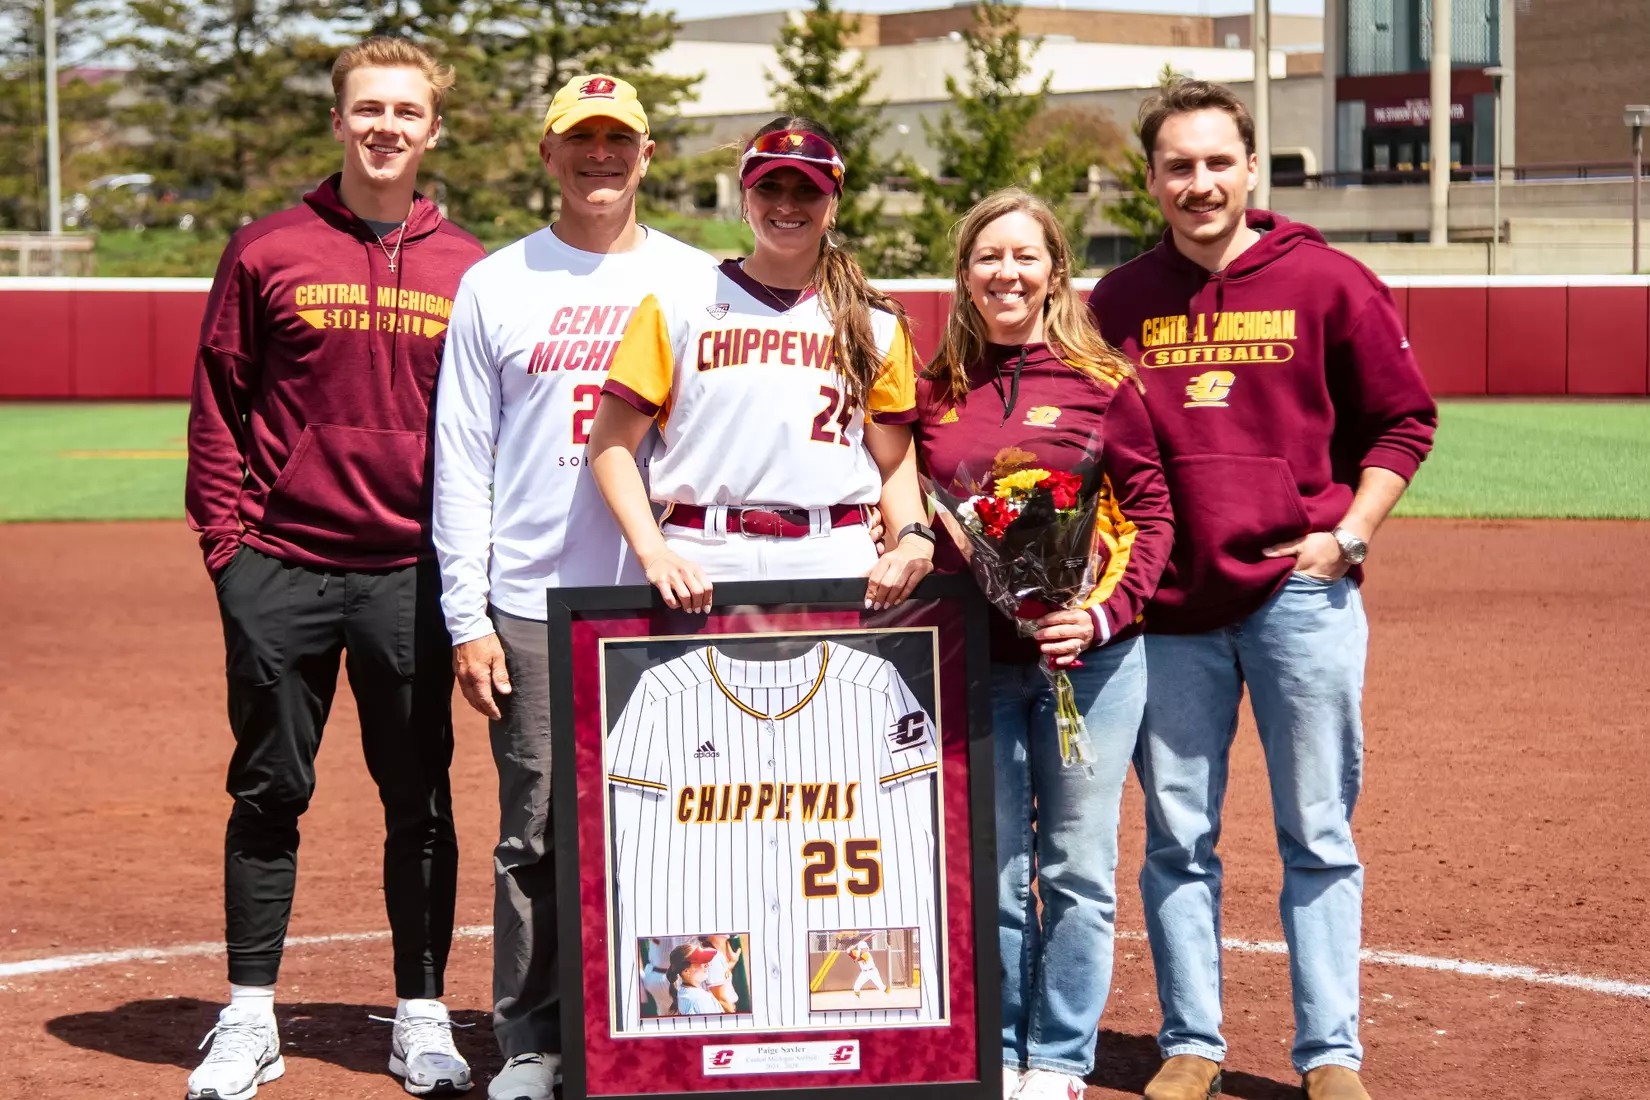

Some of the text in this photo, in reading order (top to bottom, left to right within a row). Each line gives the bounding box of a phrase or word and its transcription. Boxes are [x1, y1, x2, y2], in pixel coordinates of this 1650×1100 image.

[295, 283, 369, 306] CENTRAL
[1154, 345, 1279, 365] SOFTBALL
[693, 751, 720, 759] adidas
[675, 781, 861, 825] CHIPPEWAS
[800, 838, 883, 899] 25
[757, 1046, 779, 1055] Paige
